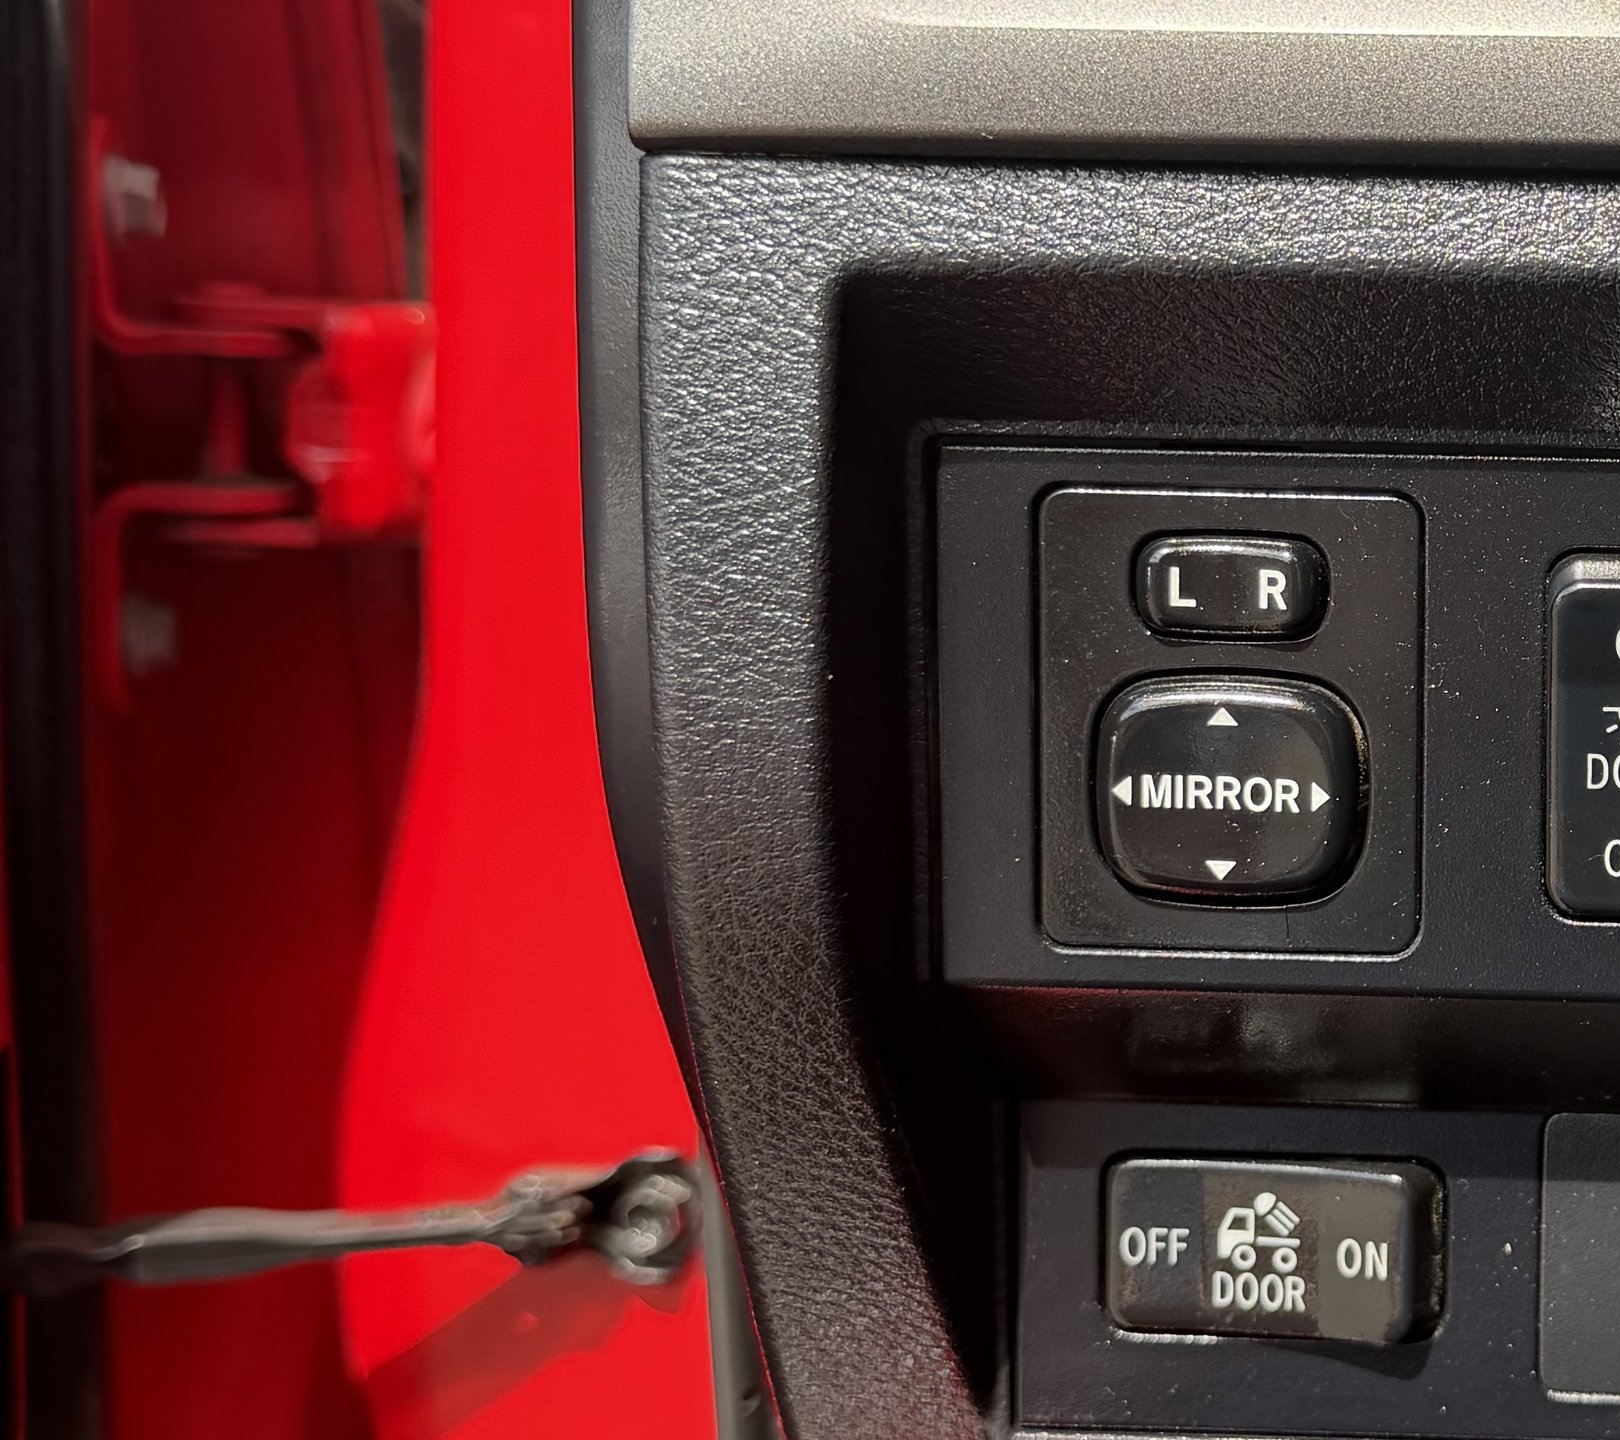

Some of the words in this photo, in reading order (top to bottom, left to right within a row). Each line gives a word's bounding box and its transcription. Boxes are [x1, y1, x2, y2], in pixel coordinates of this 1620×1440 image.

[1168, 566, 1197, 608] L
[1258, 569, 1288, 610] R
[1140, 774, 1301, 814] MIRROR
[1119, 1226, 1190, 1267] OFF
[1336, 1238, 1388, 1282] ON
[1211, 1270, 1306, 1312] DOOR
